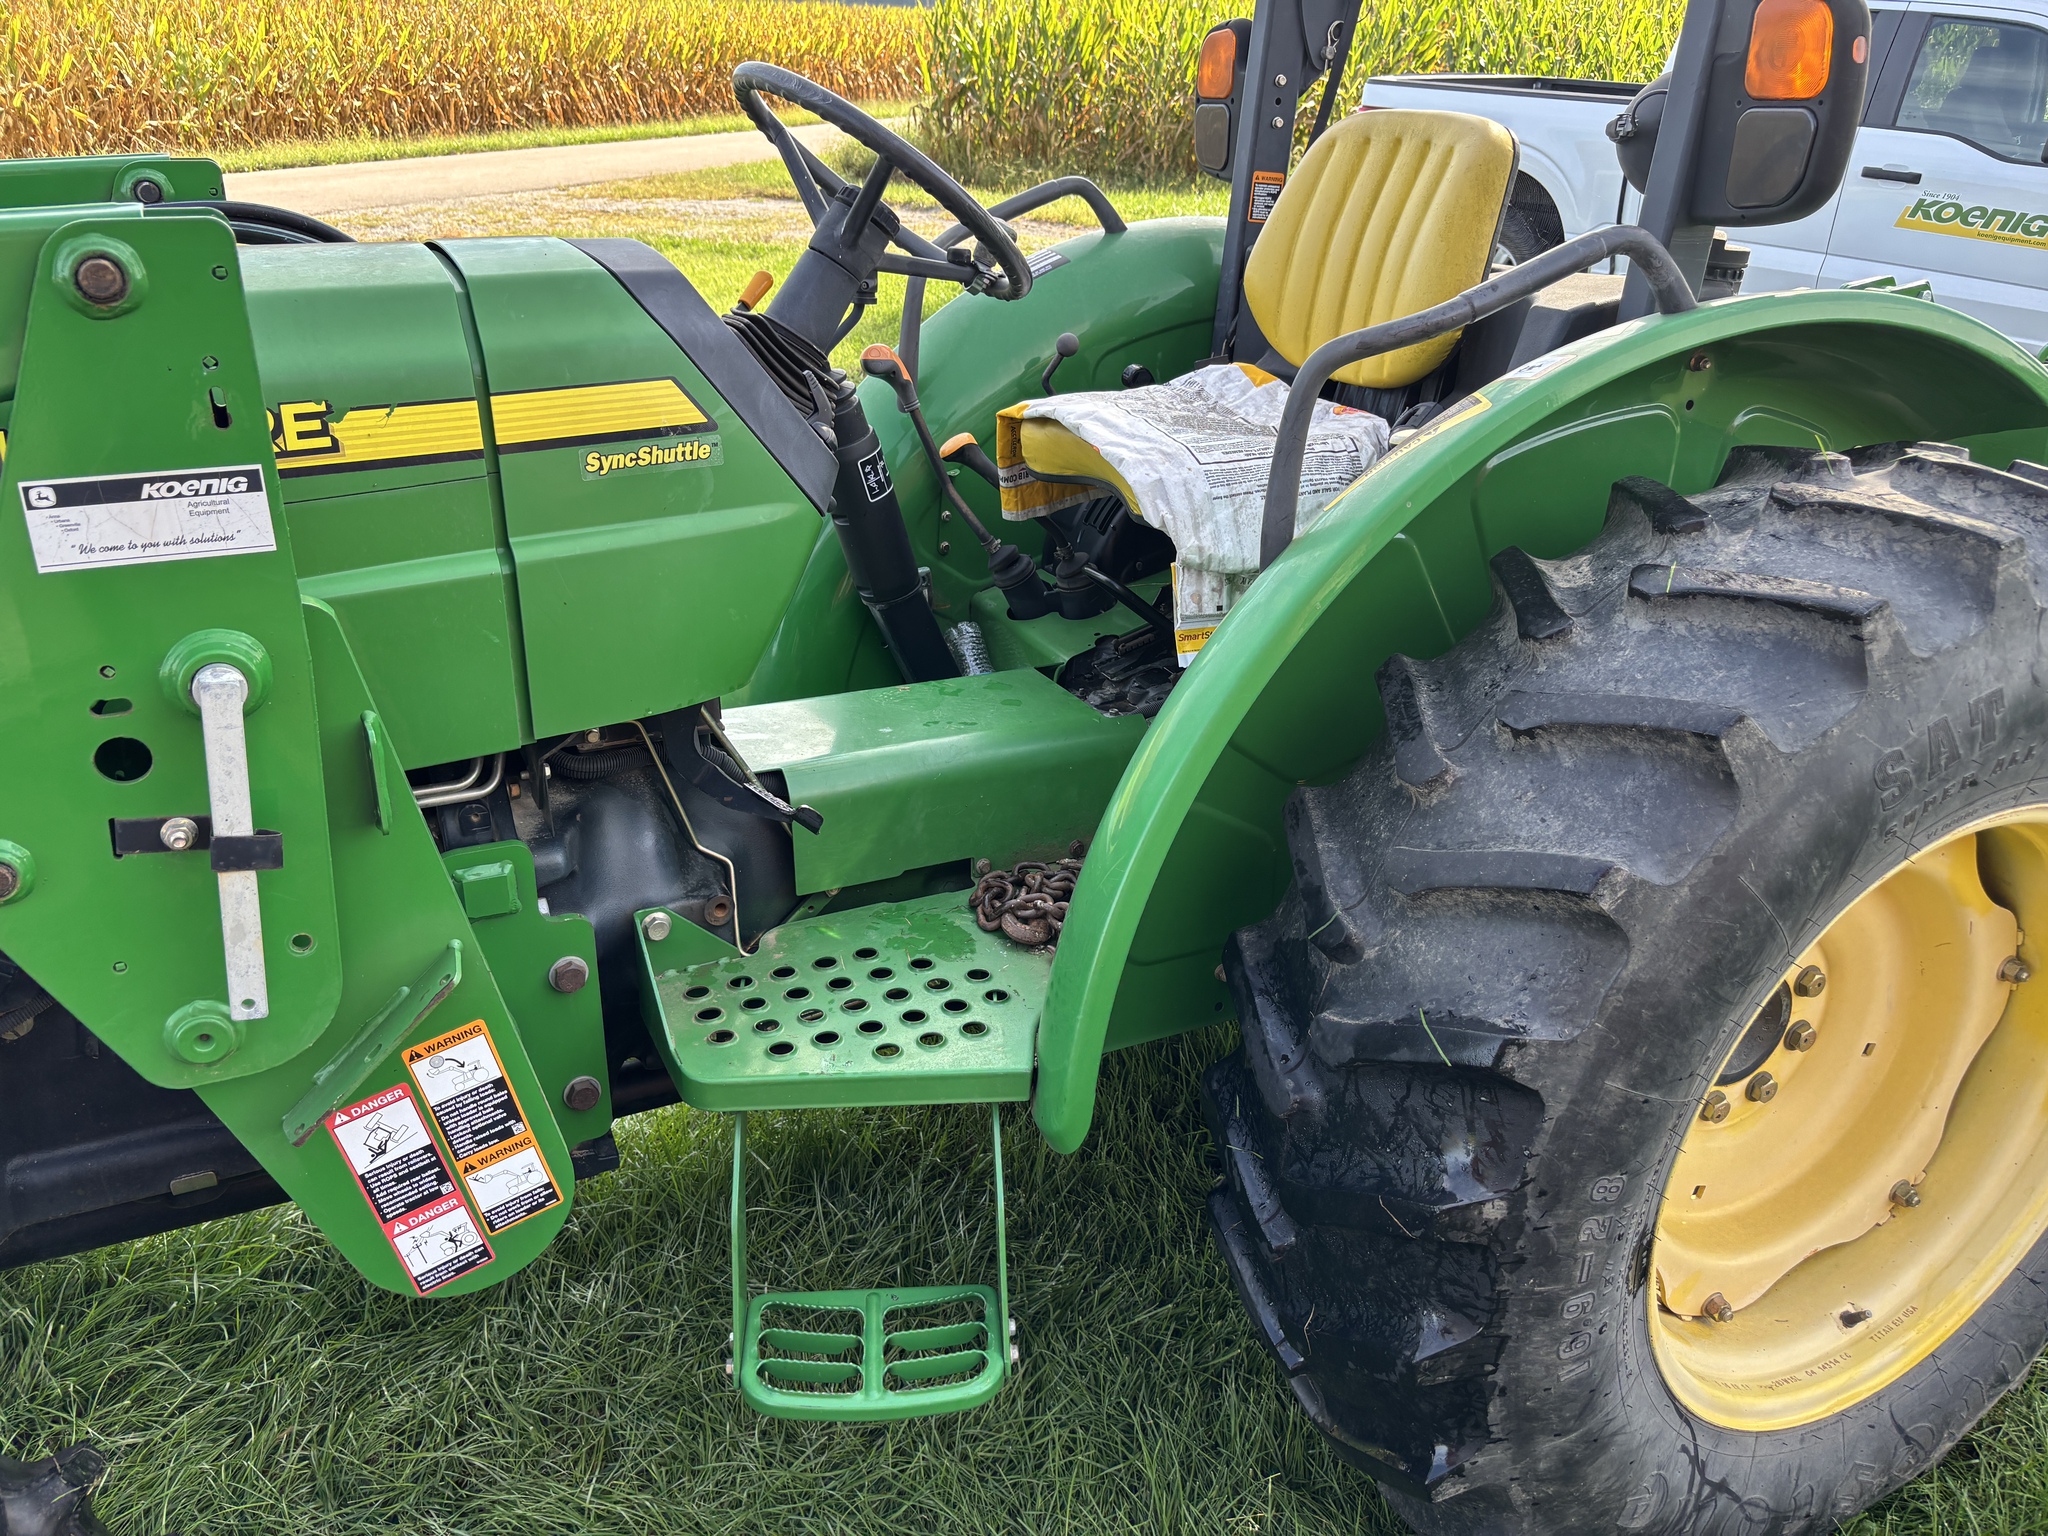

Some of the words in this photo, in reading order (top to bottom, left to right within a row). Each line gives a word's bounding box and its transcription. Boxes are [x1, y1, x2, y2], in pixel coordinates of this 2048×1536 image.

[1922, 190, 1940, 198] Since
[1942, 192, 1960, 201] 1904
[1977, 232, 2046, 247] koenigequipment.com
[584, 440, 712, 476] SyncShuttle
[188, 498, 230, 508] Agricultural
[189, 508, 230, 517] Equipment
[99, 544, 125, 553] come
[128, 540, 138, 549] to
[140, 540, 160, 552] you
[163, 534, 187, 547] with
[424, 1024, 482, 1054] WARNING
[351, 1090, 404, 1116] DANGER
[436, 1106, 455, 1115] caused
[463, 1096, 480, 1104] falling
[456, 1093, 471, 1102] injury
[459, 1104, 477, 1113] handle
[477, 1097, 493, 1105] round
[443, 1117, 461, 1125] unless
[461, 1109, 478, 1117] loader
[483, 1096, 508, 1108] equipped
[457, 1113, 482, 1125] approved
[450, 1129, 471, 1139] Lockout
[471, 1120, 493, 1130] optional
[454, 1139, 473, 1148] Handle
[473, 1132, 490, 1140] raised
[490, 1125, 504, 1133] loads
[459, 1150, 473, 1158] Carry
[477, 1137, 532, 1166] WARNING
[364, 1167, 385, 1178] Serious
[386, 1160, 402, 1169] injury
[409, 1150, 424, 1158] death
[378, 1169, 394, 1178] result
[370, 1180, 381, 1189] Use
[381, 1174, 398, 1183] ROPS
[398, 1168, 409, 1176] and
[409, 1160, 431, 1170] seatbelt
[375, 1190, 387, 1199] Add
[387, 1181, 410, 1193] required
[378, 1195, 393, 1203] Move
[393, 1186, 412, 1196] wheels
[418, 1175, 436, 1185] widest
[380, 1189, 418, 1208] recommended
[383, 1202, 405, 1214] Operate
[405, 1194, 423, 1203] tractor
[408, 1199, 459, 1226] DANGER
[1868, 1324, 1893, 1344] TITAN
[1902, 1305, 1920, 1321] USA
